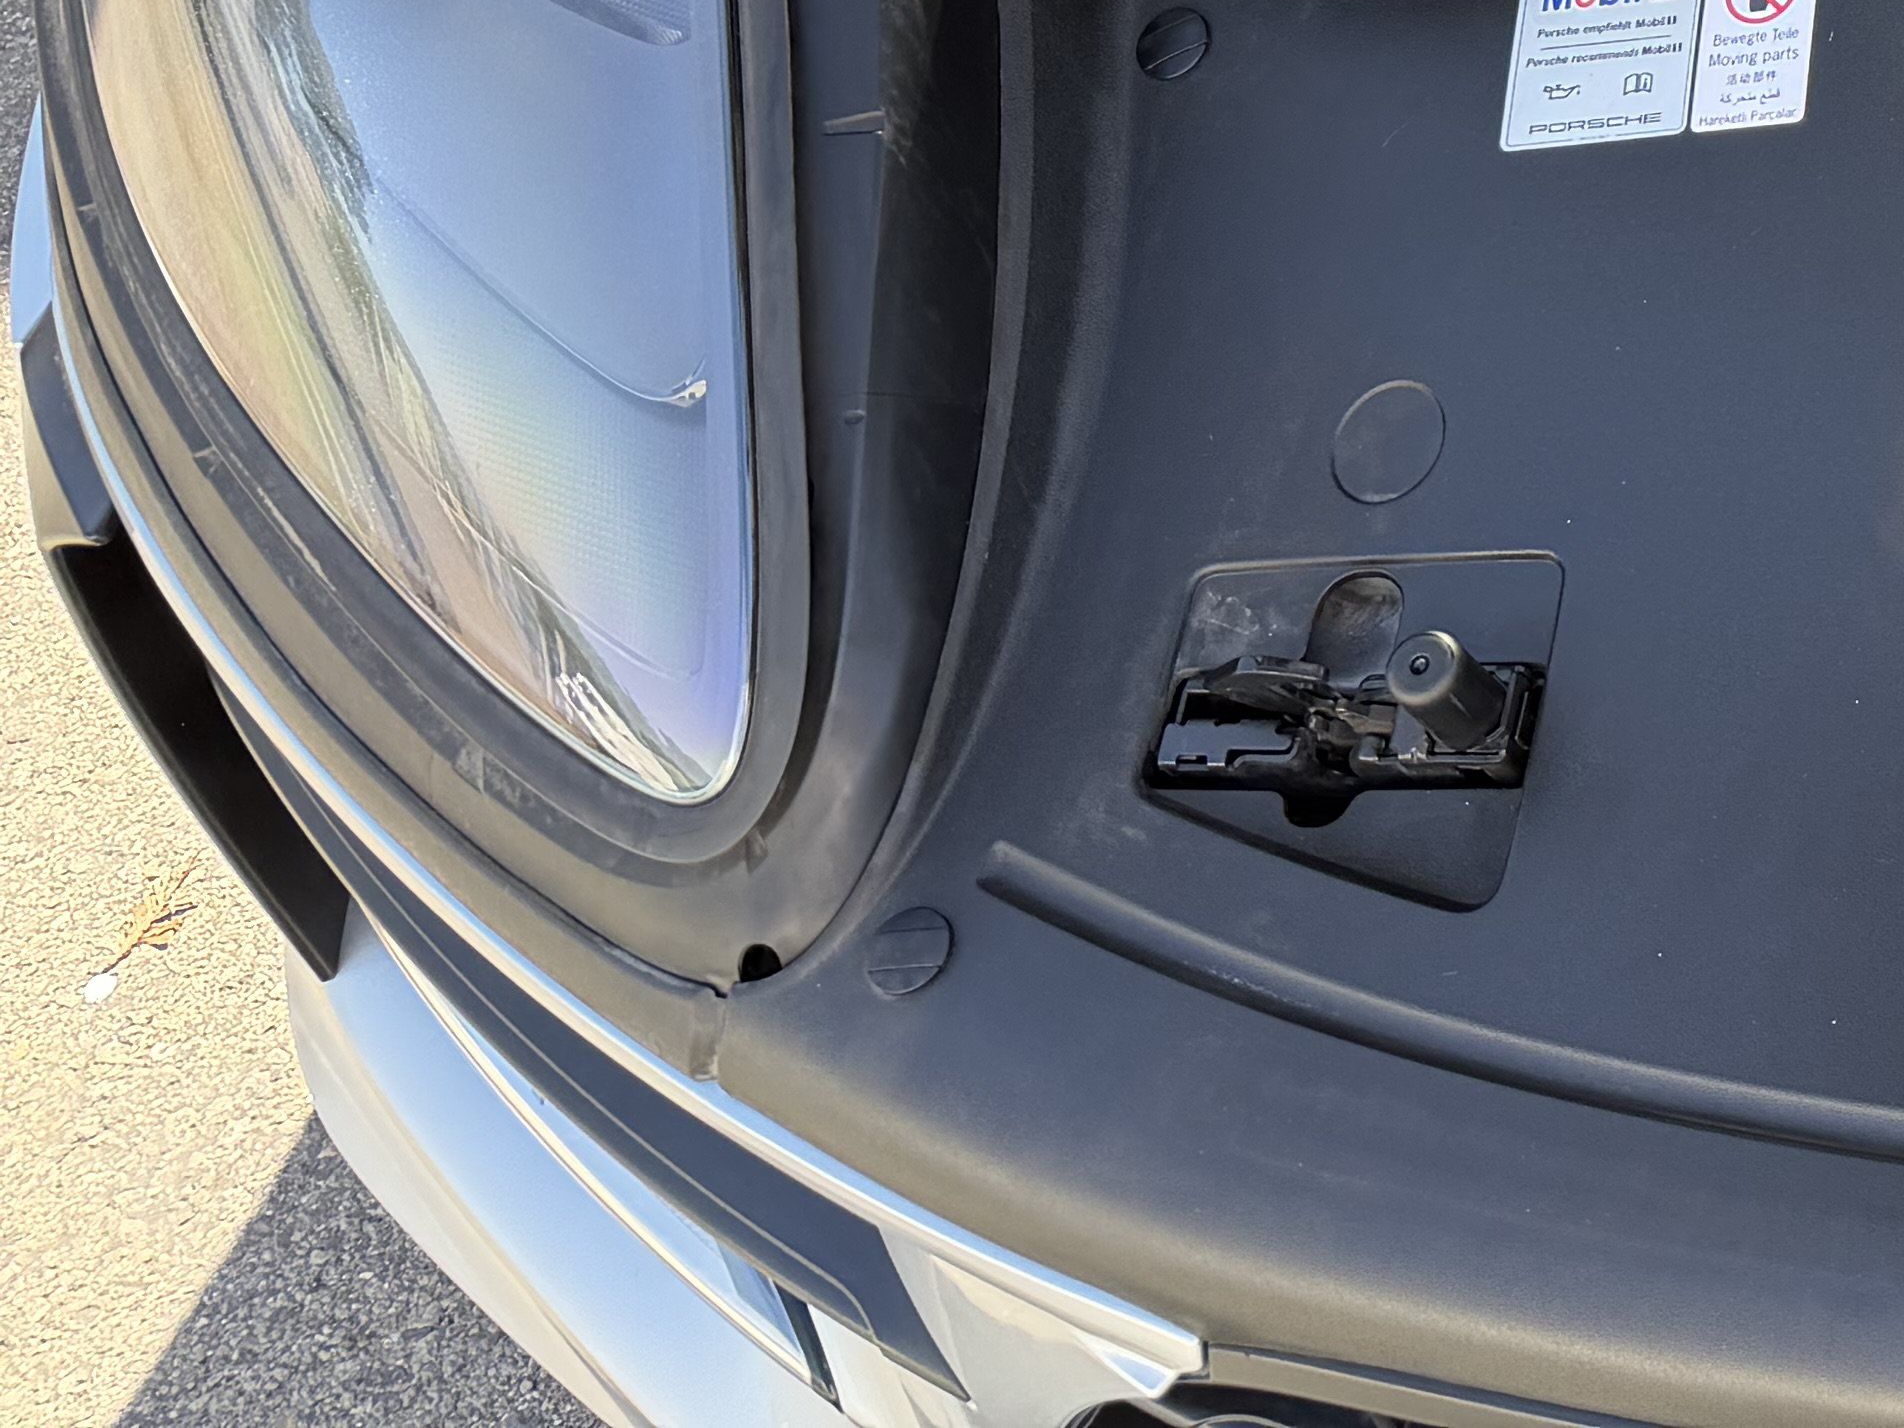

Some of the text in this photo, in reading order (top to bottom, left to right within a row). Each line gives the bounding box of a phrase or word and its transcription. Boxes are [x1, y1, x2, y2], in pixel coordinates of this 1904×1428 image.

[1537, 25, 1580, 39] Porsche
[1713, 32, 1767, 47] Bewegte
[1526, 54, 1568, 68] Porsche
[1571, 48, 1639, 63] recommends
[1709, 46, 1799, 67] Moving parts
[1528, 112, 1662, 135] PORSCHE
